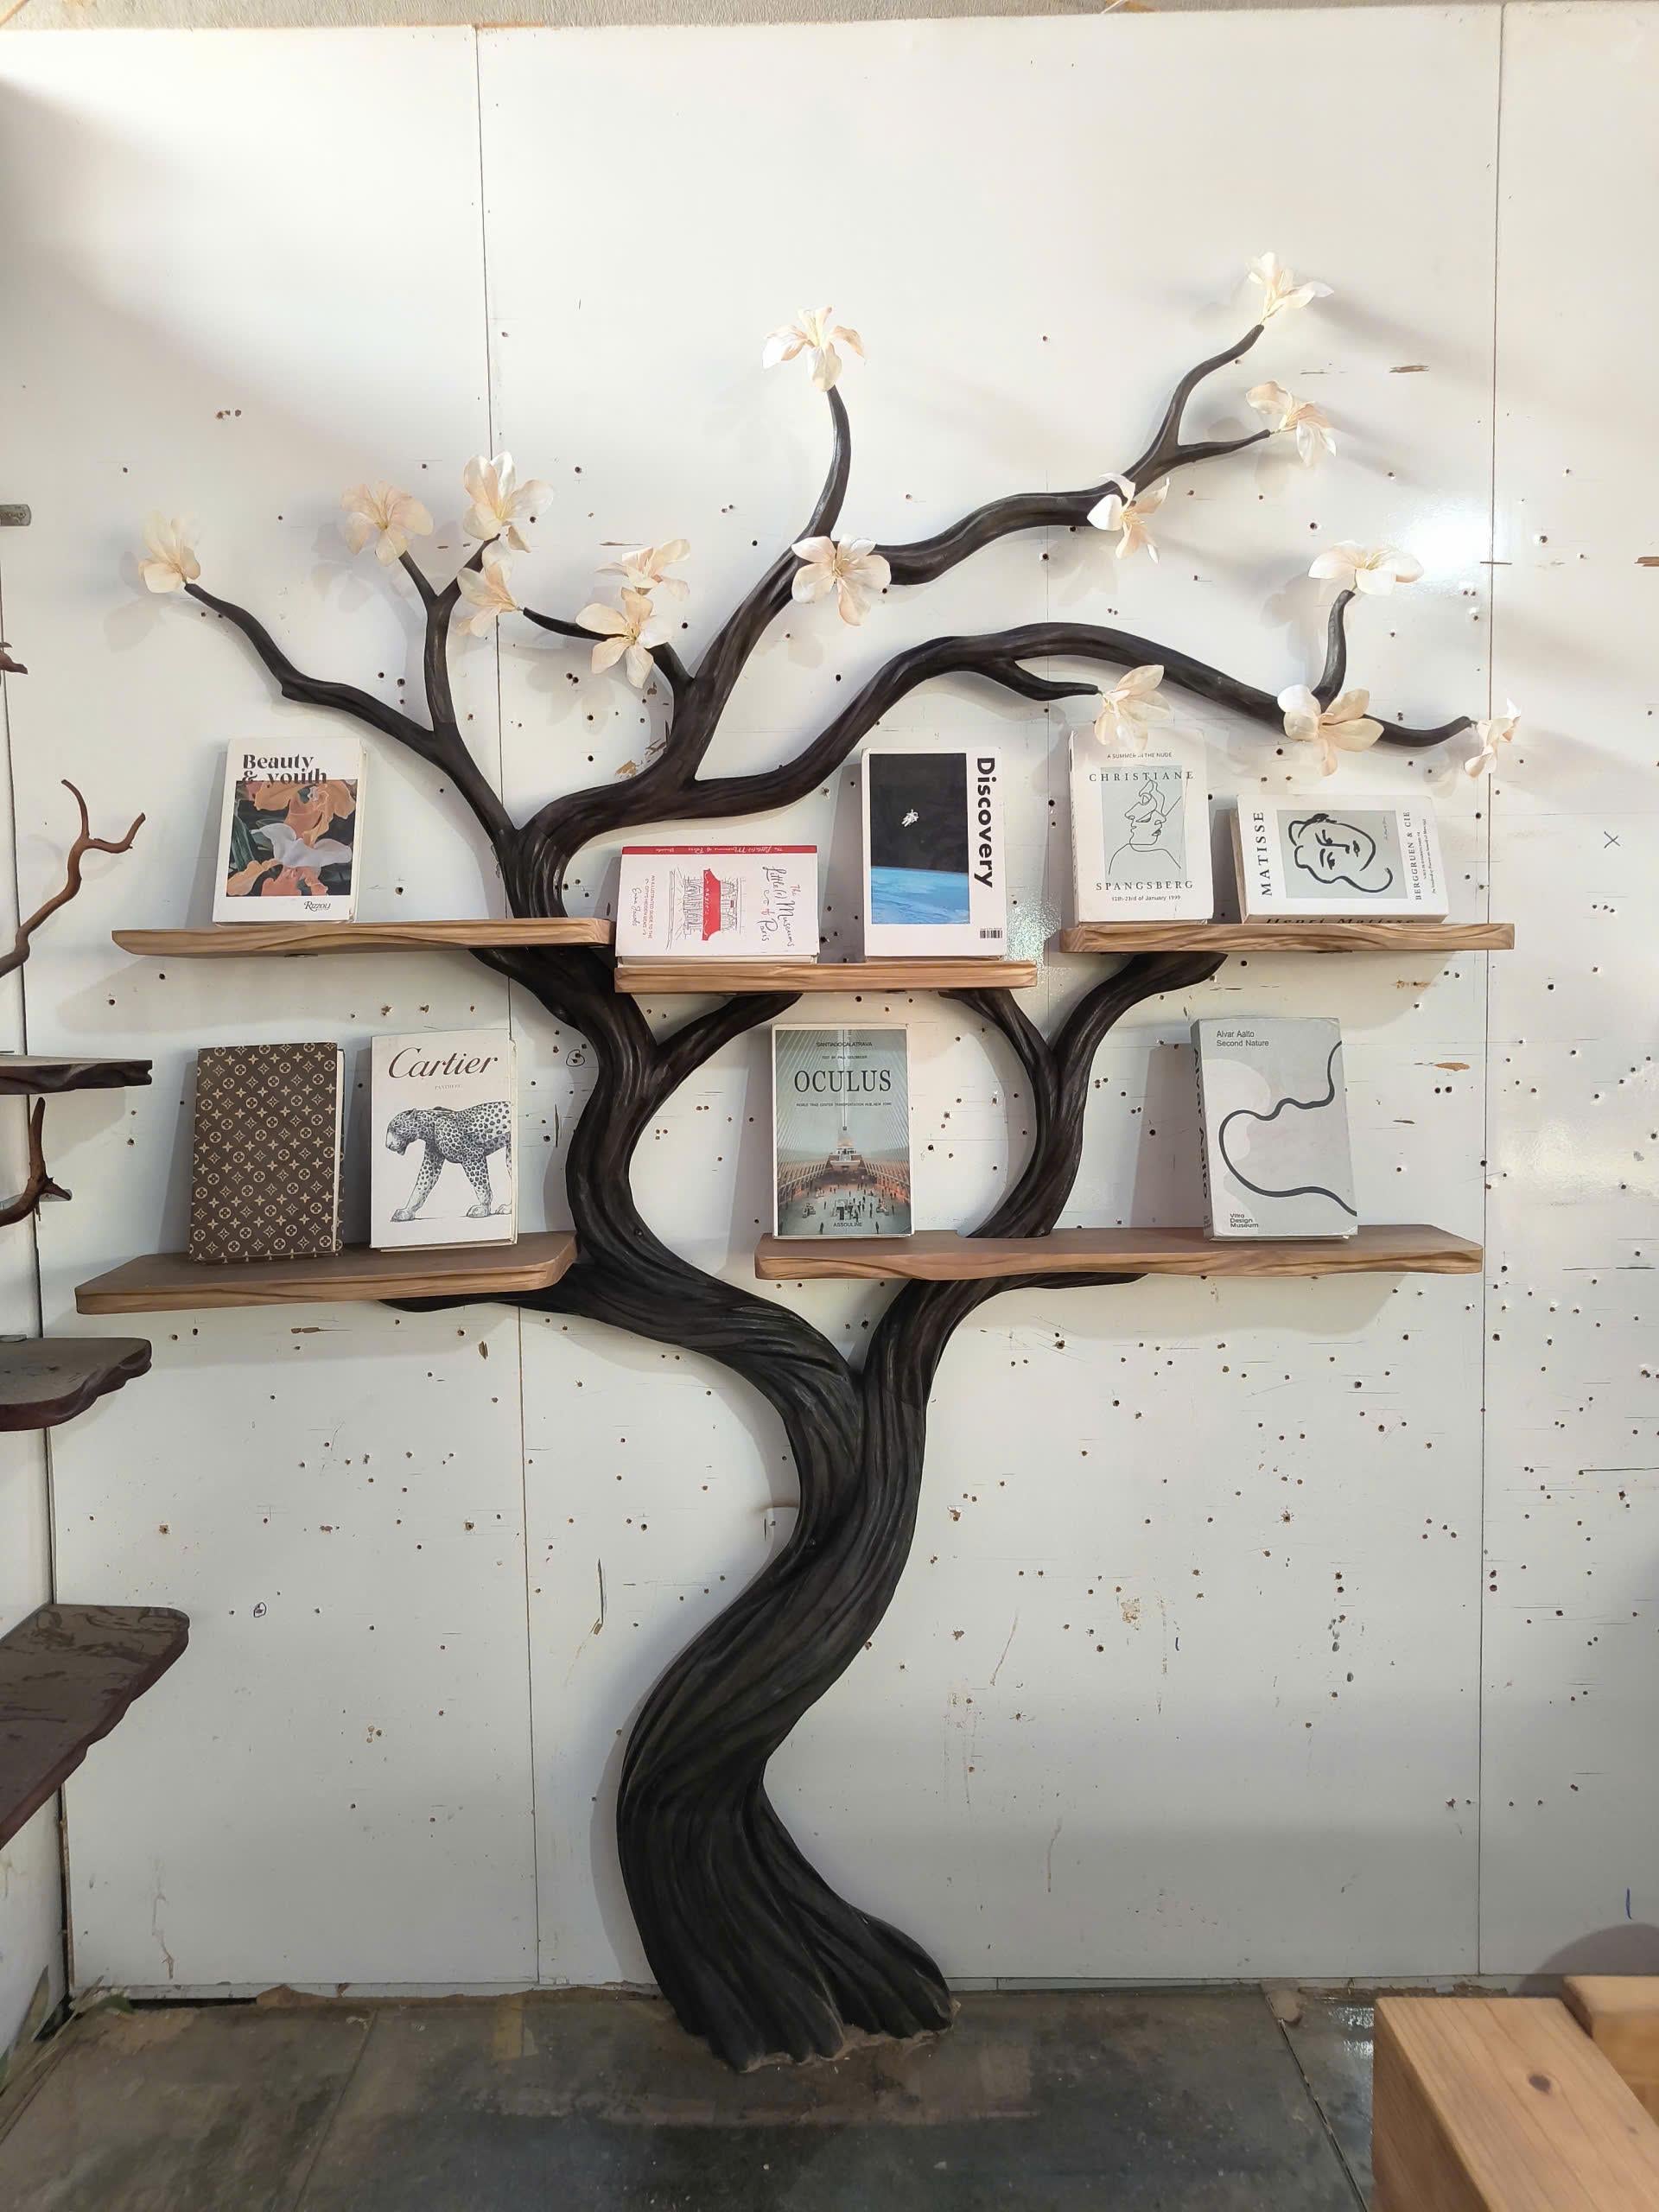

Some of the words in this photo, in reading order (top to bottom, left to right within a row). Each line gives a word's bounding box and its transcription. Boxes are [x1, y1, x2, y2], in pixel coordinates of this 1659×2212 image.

[243, 753, 315, 772] Beauty
[242, 770, 258, 785] &
[266, 768, 327, 788] youth
[1089, 771, 1194, 782] CHRISTIANE
[974, 757, 997, 888] Discovery
[1403, 811, 1412, 828] CIE
[1253, 810, 1273, 897] MATISSE
[1096, 880, 1194, 891] SPANGSBERG
[757, 918, 779, 942] Paris
[776, 899, 796, 947] Museums
[388, 1046, 498, 1078] Cartier
[794, 1070, 892, 1092] OCULUS
[1193, 1047, 1203, 1118] Alvar
[1199, 1126, 1209, 1199] Aalto
